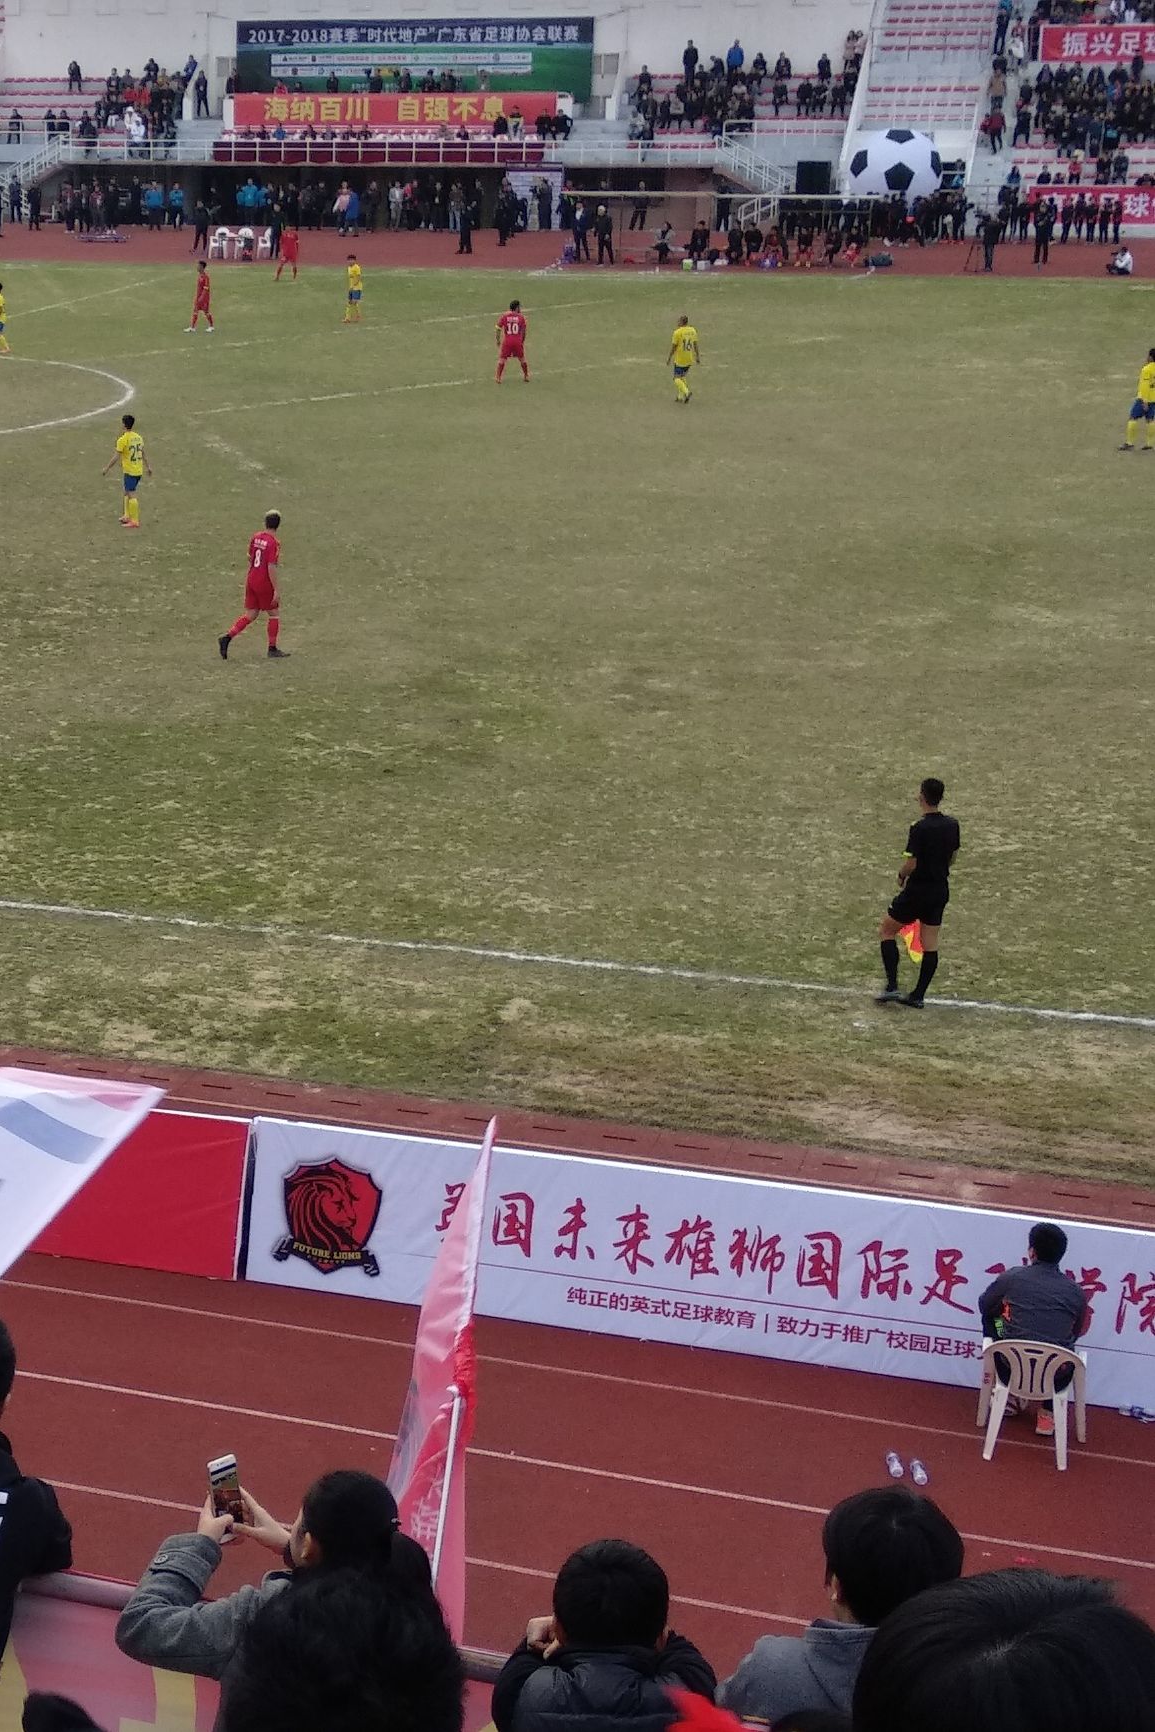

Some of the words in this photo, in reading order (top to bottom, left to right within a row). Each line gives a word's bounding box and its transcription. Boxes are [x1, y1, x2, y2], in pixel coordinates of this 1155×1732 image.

[264, 97, 371, 121] 海纳百川
[397, 97, 505, 122] 自强不息
[507, 323, 519, 335] 10
[253, 549, 262, 568] 8
[292, 1241, 331, 1259] FUTURE
[333, 1251, 362, 1260] LIONS
[567, 1286, 757, 1330] 纯正的英式足球教育
[776, 1315, 985, 1361] 致力于推广校园足球
